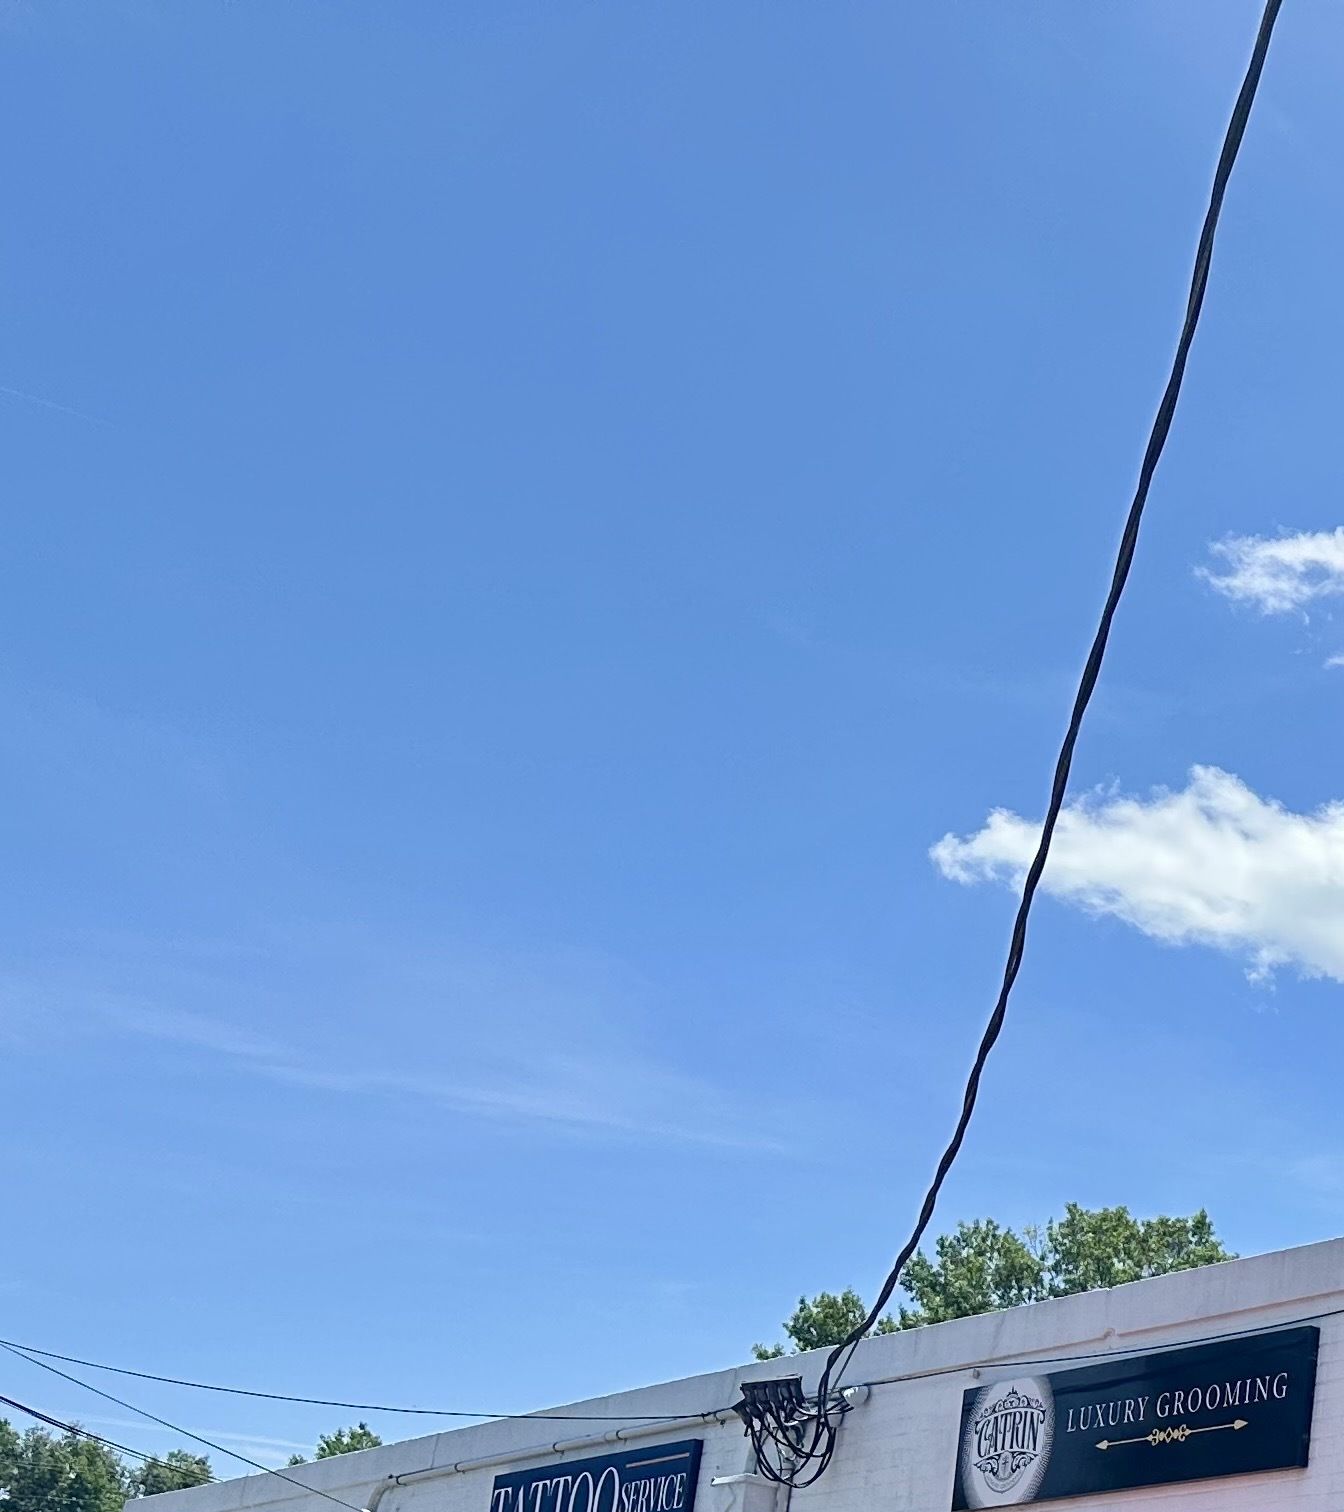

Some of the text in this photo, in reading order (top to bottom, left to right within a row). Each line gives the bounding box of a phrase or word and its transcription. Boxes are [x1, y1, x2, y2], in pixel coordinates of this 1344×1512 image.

[1066, 1373, 1289, 1433] LUXURY GROOMING
[976, 1410, 1042, 1458] CATRIN
